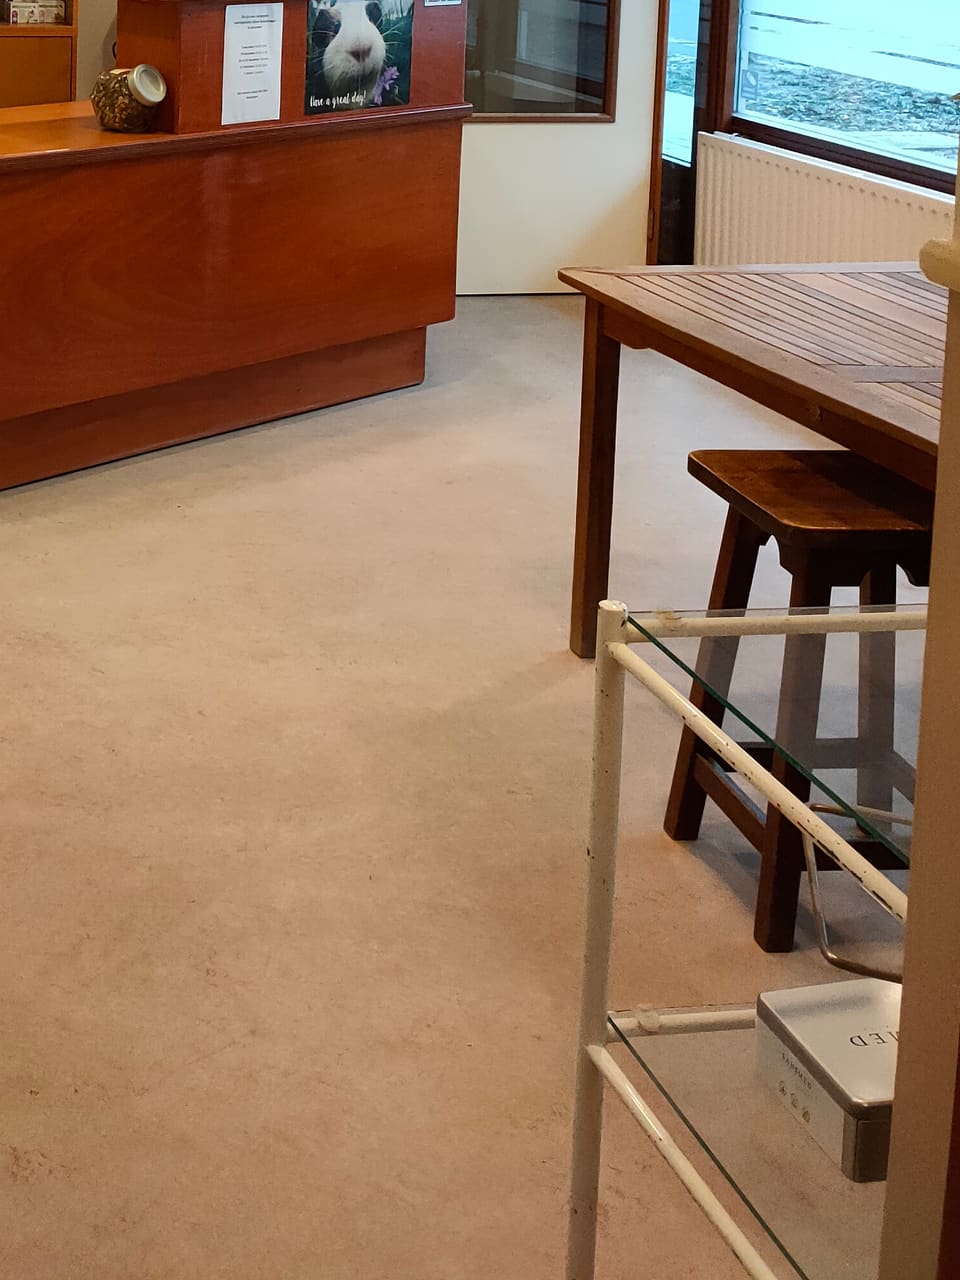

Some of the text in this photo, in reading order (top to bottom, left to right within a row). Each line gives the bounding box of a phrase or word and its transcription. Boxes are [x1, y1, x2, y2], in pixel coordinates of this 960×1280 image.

[310, 90, 367, 109] Have a great day!
